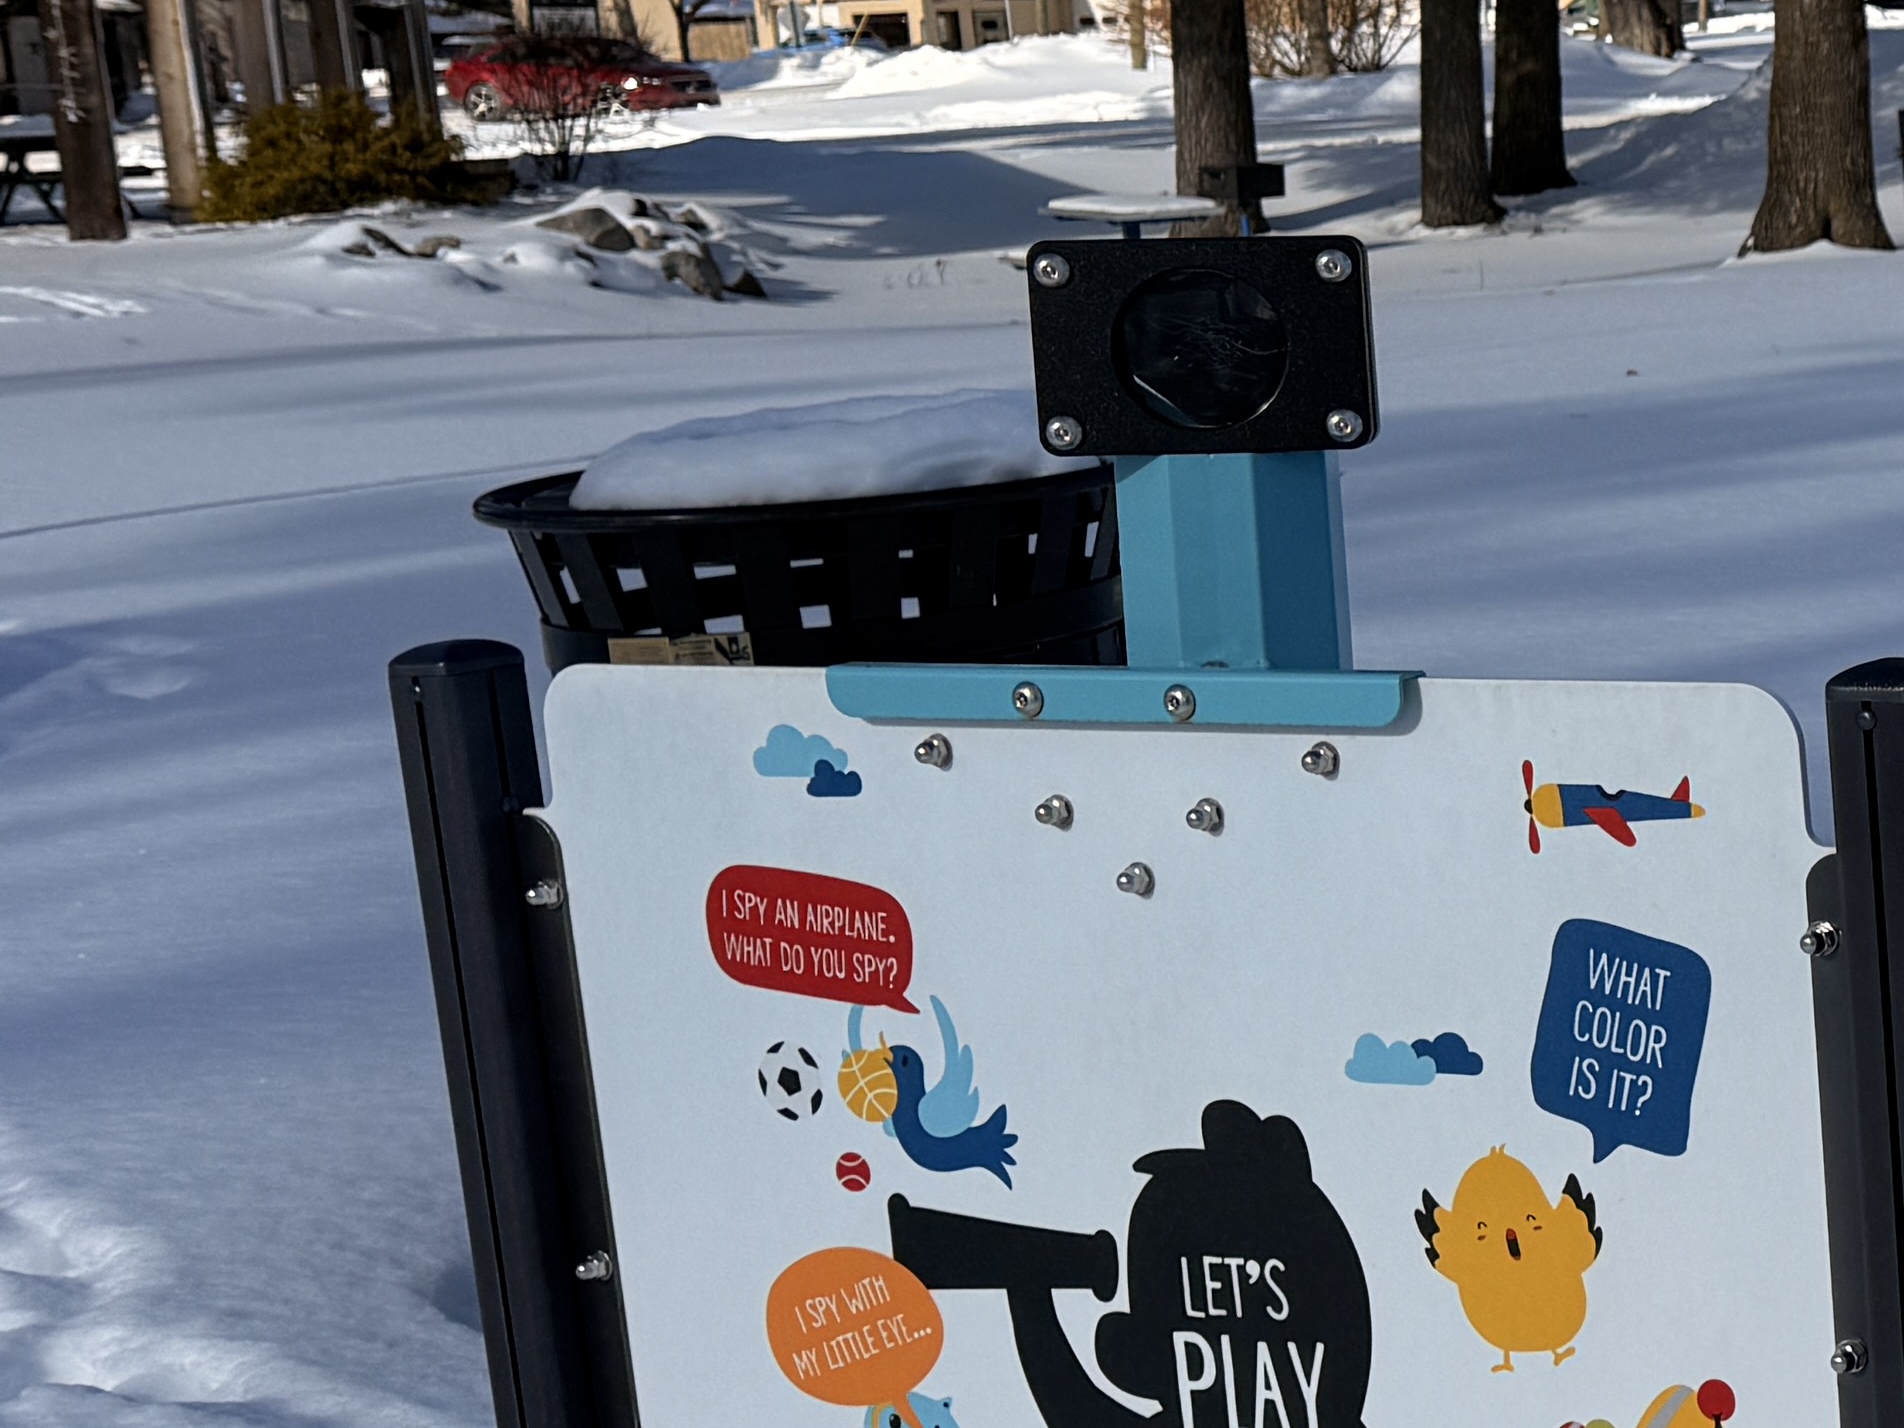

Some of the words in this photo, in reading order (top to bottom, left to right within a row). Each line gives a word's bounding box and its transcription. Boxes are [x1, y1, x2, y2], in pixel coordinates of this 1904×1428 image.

[722, 890, 727, 917] I
[734, 889, 767, 925] SPY
[775, 898, 799, 929] AN
[806, 903, 896, 943] AIRPLANE.
[724, 932, 773, 967] WHAT
[780, 942, 804, 974] DO
[810, 946, 846, 979] YOU
[853, 953, 898, 989] SPY?
[1589, 947, 1671, 1011] WHAT
[1573, 999, 1667, 1069] COLOR
[1569, 1056, 1599, 1100] IS
[1607, 1068, 1653, 1116] IT?
[794, 1306, 807, 1335] I
[805, 1294, 841, 1328] SPY
[840, 1275, 891, 1315] WITH
[792, 1348, 821, 1380] MY
[822, 1325, 880, 1371] LITTLE
[877, 1313, 932, 1349] EYE...
